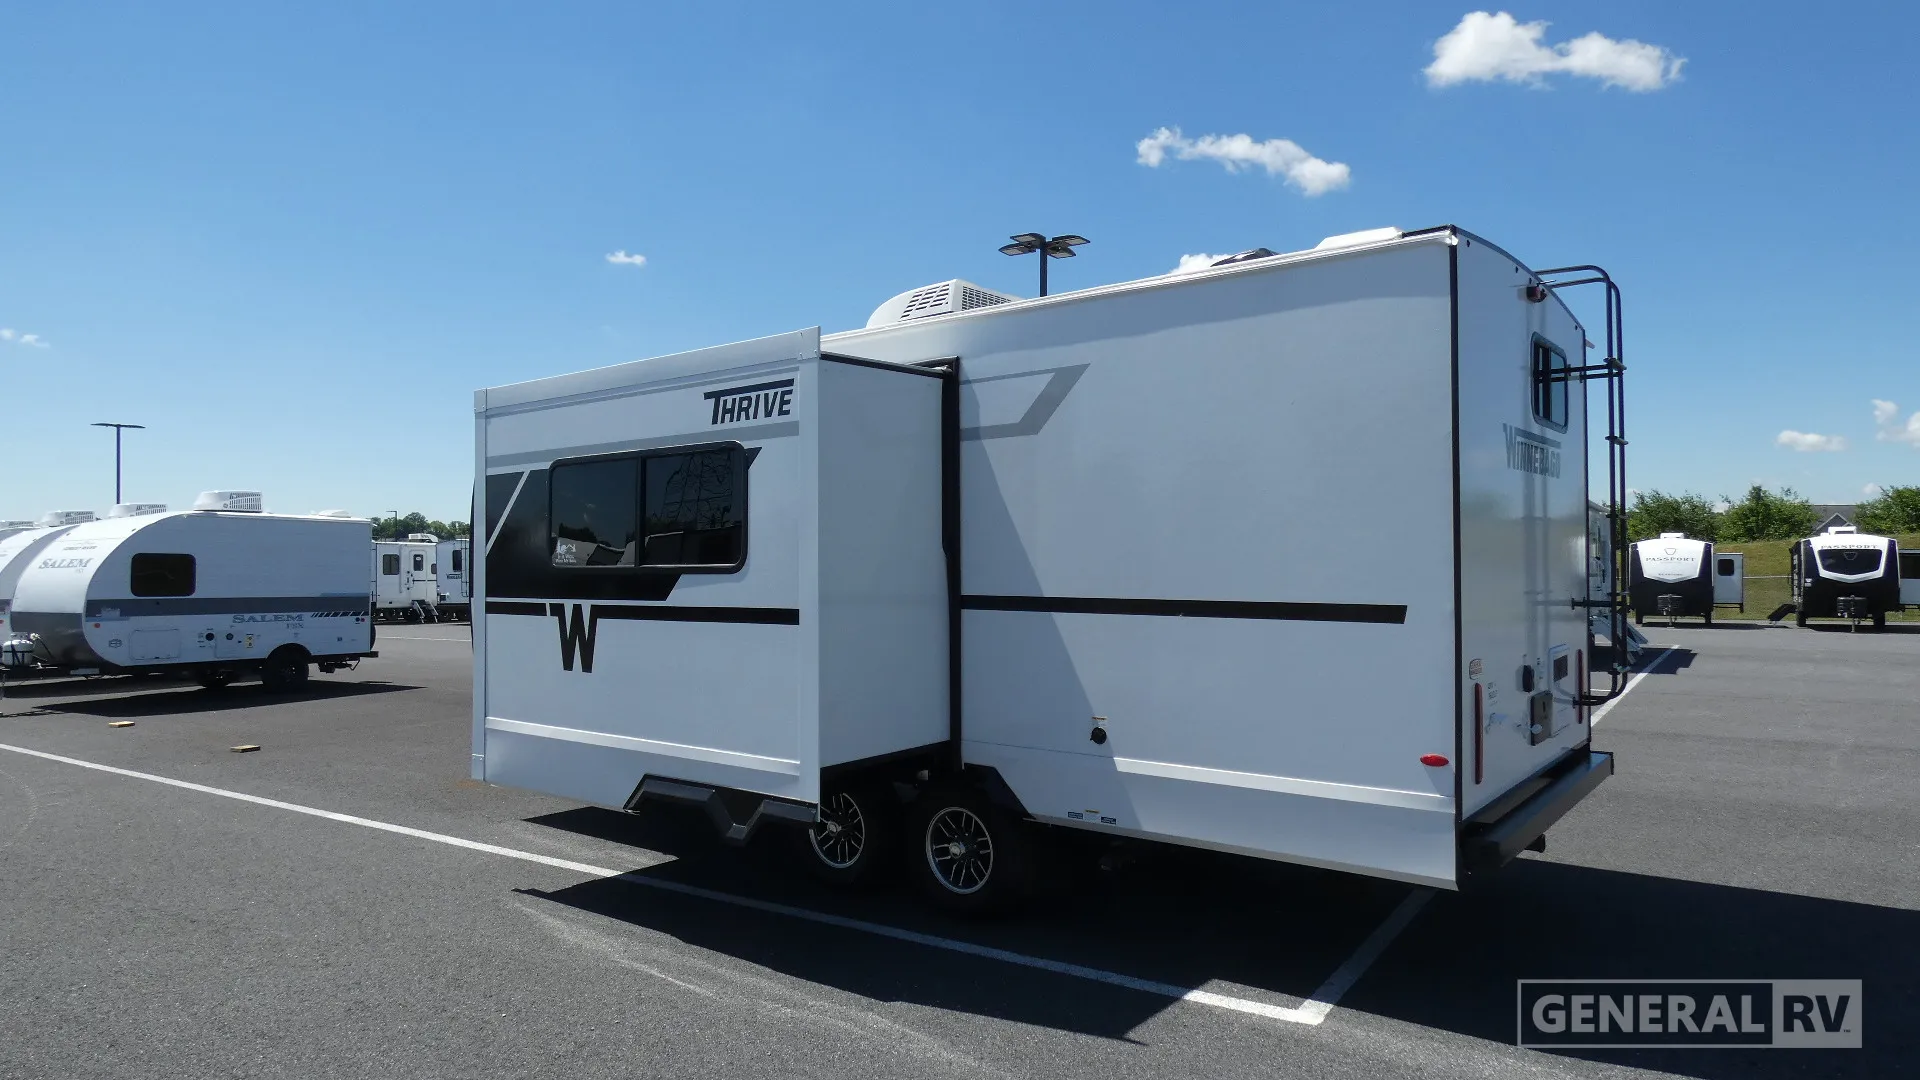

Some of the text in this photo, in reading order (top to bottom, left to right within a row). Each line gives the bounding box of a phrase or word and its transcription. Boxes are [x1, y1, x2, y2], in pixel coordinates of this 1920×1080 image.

[704, 378, 795, 425] THRIVE
[1502, 422, 1562, 480] WINNEBAGO
[39, 558, 93, 569] SALEM
[232, 613, 304, 623] SALEM
